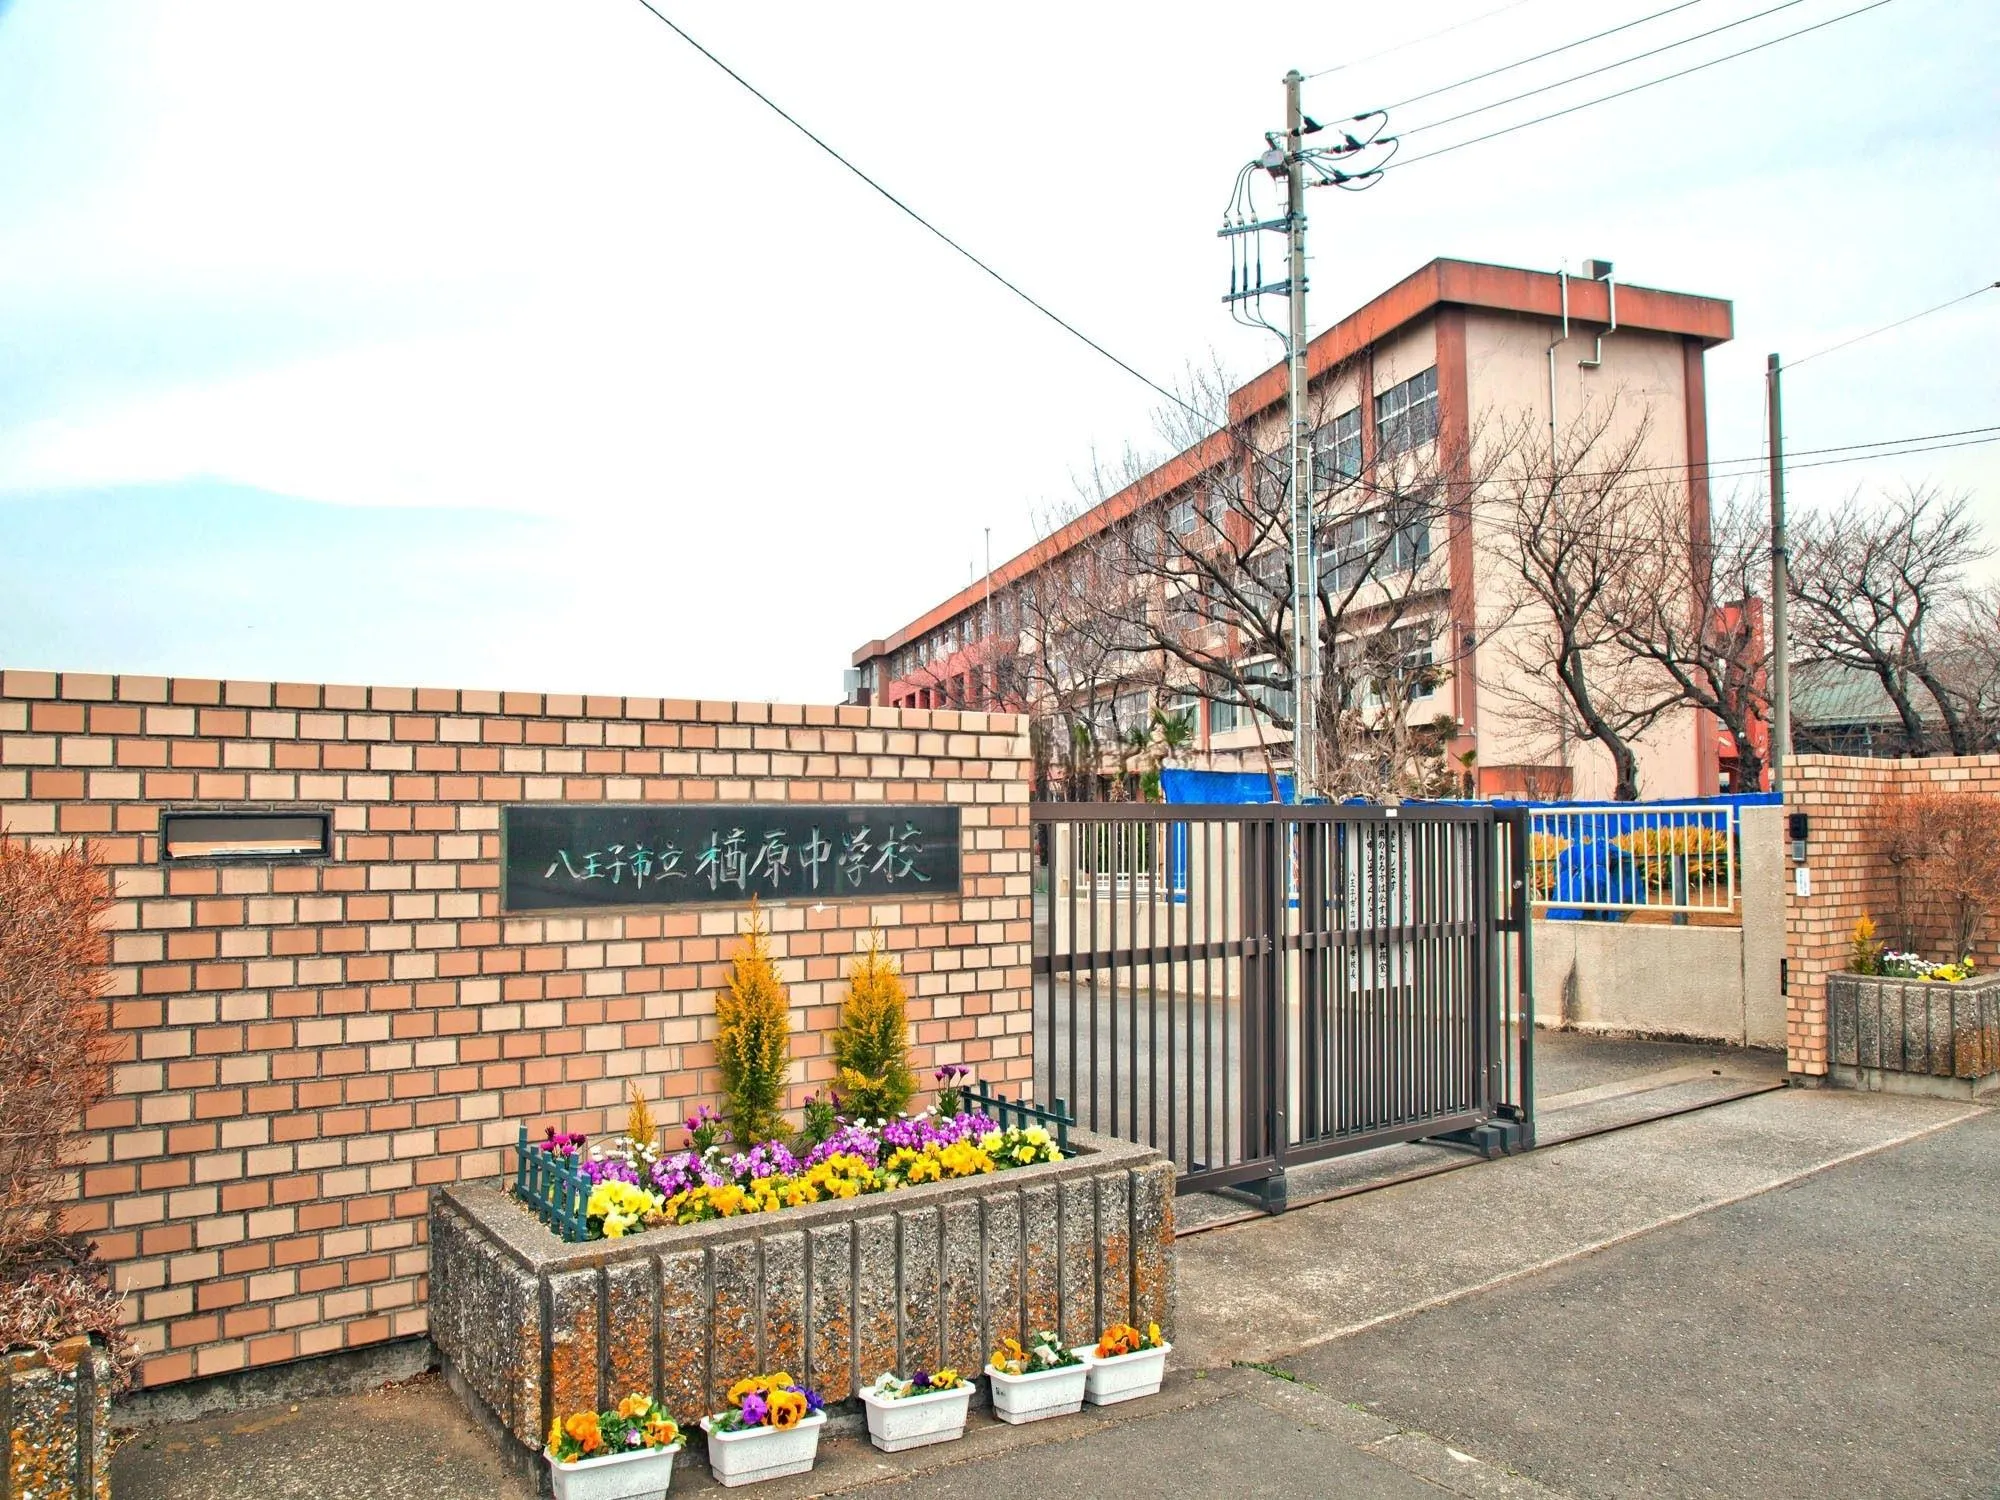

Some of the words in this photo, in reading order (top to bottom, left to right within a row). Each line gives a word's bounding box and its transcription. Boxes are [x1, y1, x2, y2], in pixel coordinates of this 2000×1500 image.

[544, 819, 932, 890] 八王子市立楢原中学校
